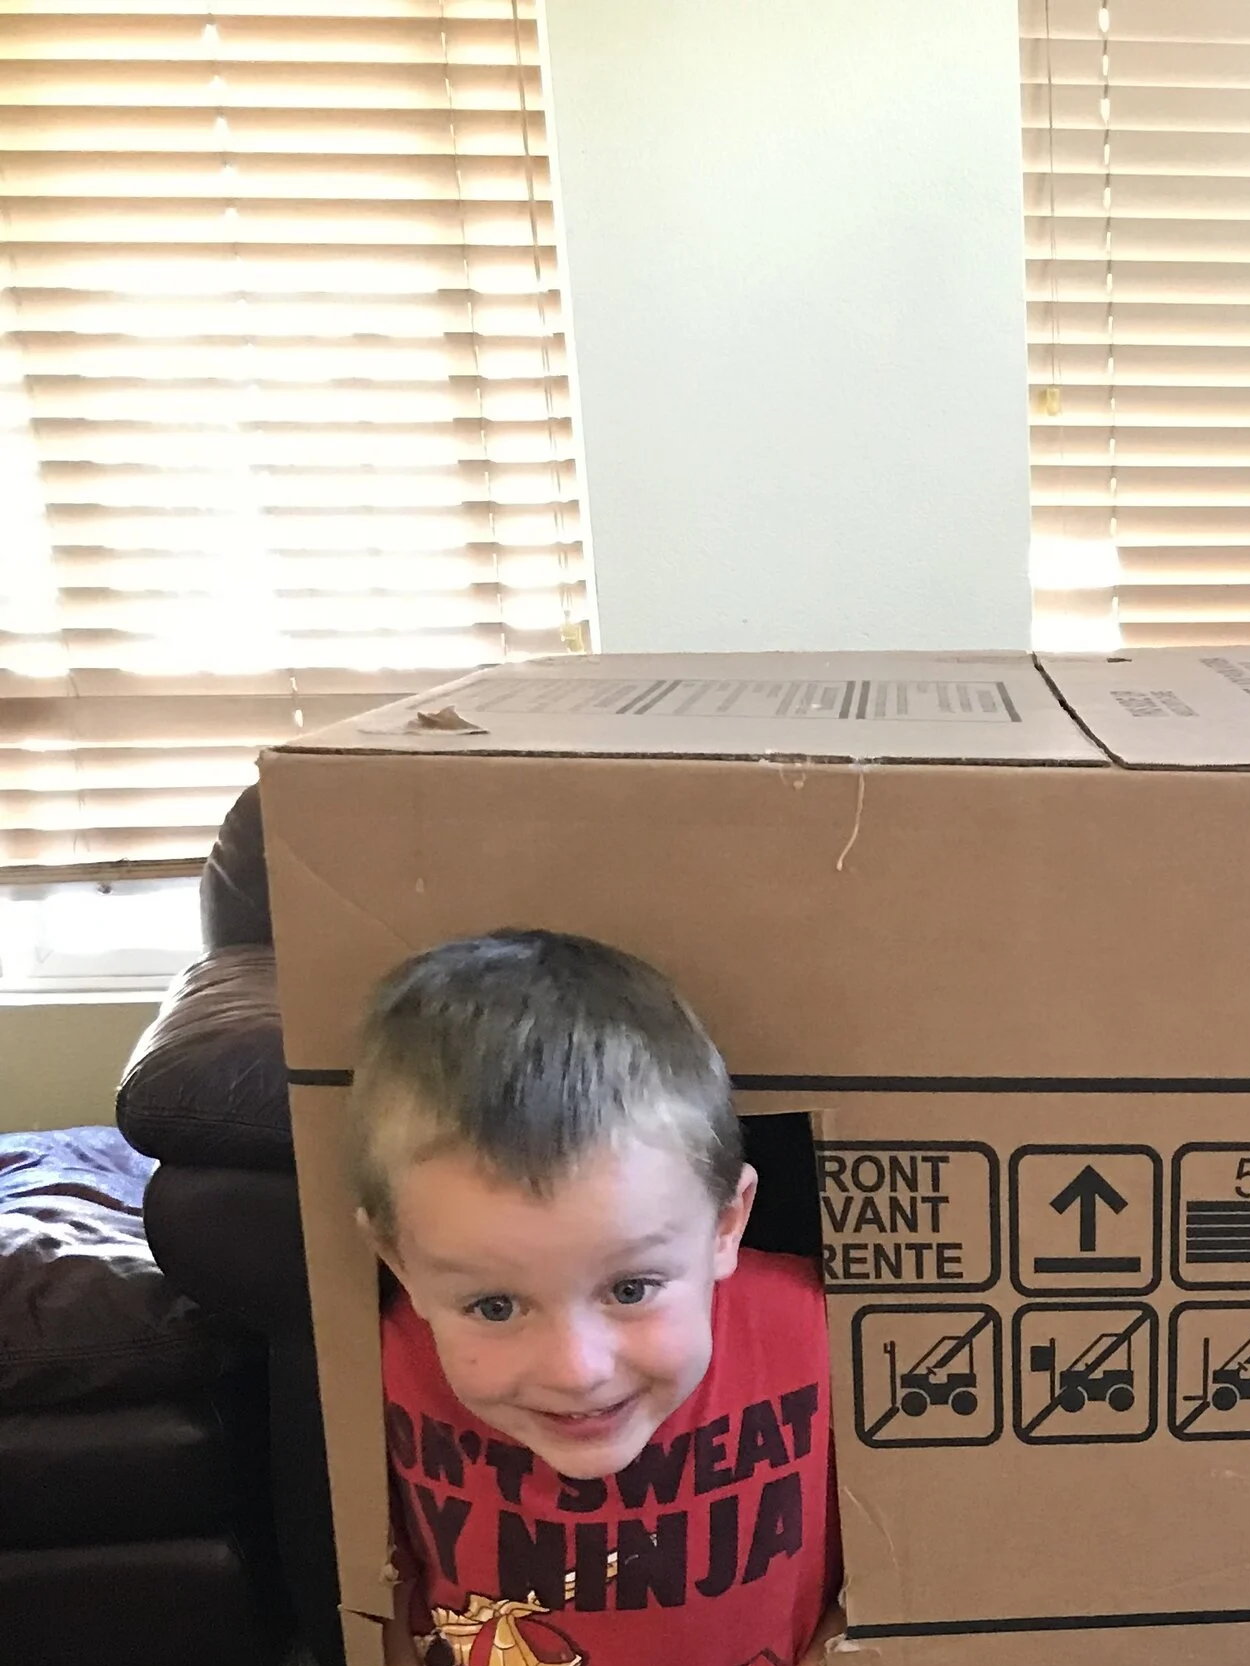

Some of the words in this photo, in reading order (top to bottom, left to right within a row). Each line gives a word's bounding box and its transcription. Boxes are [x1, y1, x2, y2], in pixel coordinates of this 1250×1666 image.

[817, 1155, 949, 1193] RONT
[821, 1196, 949, 1233] VANT
[823, 1243, 963, 1280] RENTE
[557, 1382, 818, 1512] SWEAT
[498, 1471, 803, 1613] NINJA
